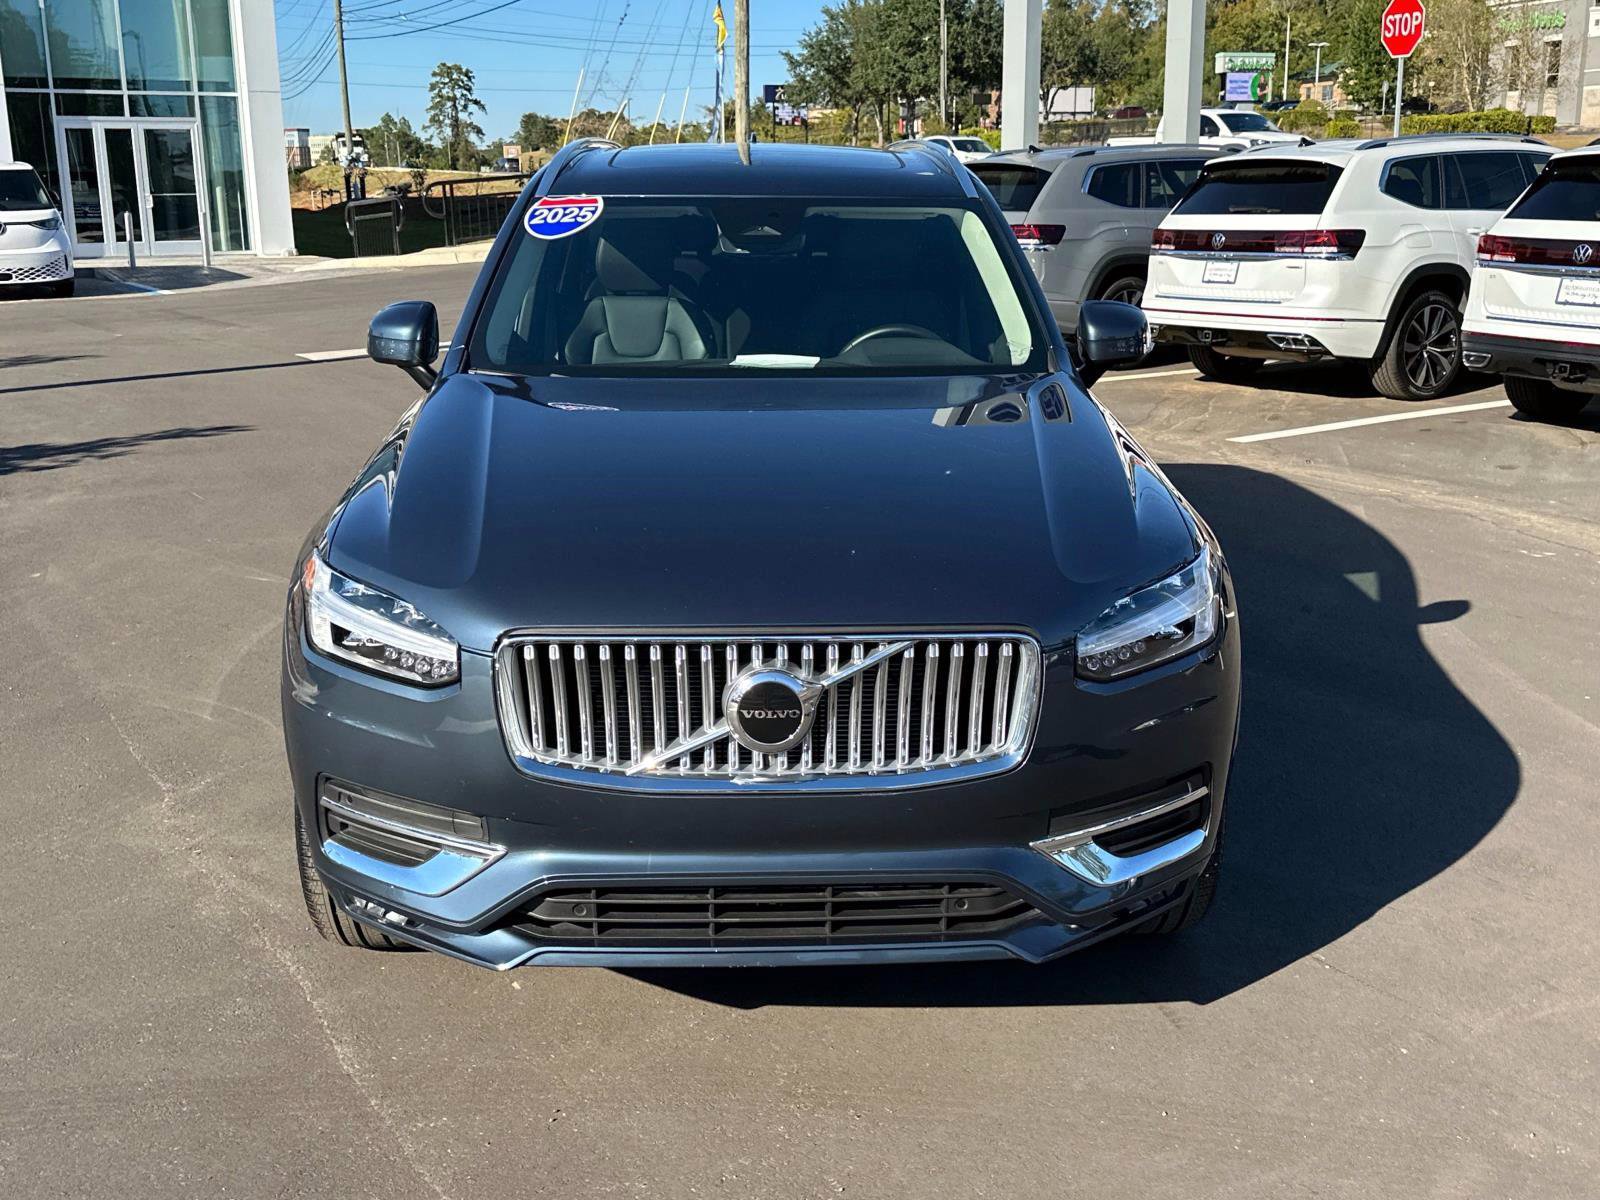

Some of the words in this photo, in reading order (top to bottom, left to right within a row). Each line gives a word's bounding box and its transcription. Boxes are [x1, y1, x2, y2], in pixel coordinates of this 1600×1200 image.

[1384, 11, 1422, 38] STOP
[529, 207, 595, 225] 2025
[740, 709, 801, 719] VOLVO
